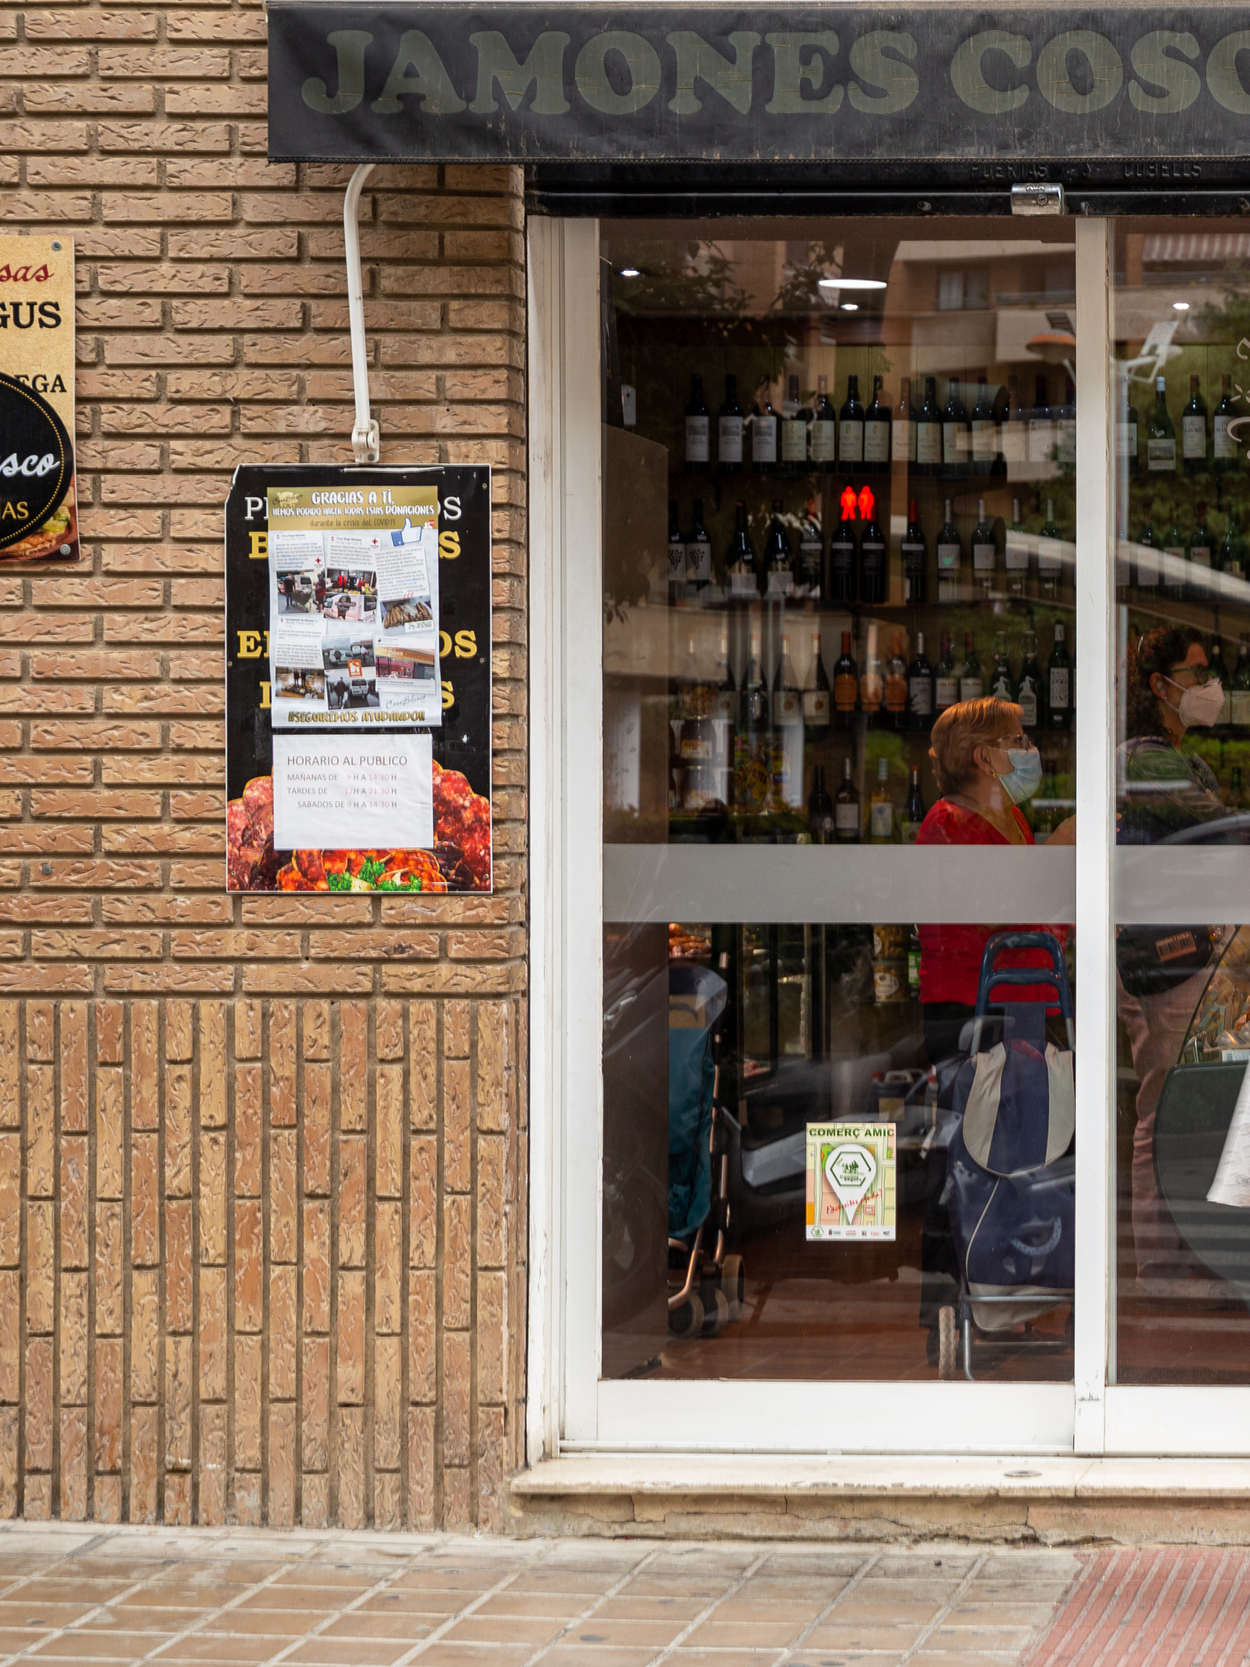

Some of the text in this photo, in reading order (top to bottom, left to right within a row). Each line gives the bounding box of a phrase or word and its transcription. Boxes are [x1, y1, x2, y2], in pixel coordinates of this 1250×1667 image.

[301, 28, 919, 117] JAMONES
[311, 491, 364, 505] GRACIAS
[368, 491, 379, 504] A
[272, 508, 295, 516] HEMOS
[296, 508, 322, 516] PODIDO
[323, 508, 342, 516] HACER
[366, 507, 384, 515] ESTAS
[385, 505, 435, 515] DONACIONES
[309, 519, 334, 527] durante
[287, 755, 408, 766] HORARIO AL PUBLICO
[287, 772, 327, 781] MAÑANAS
[287, 787, 316, 795] TARDES
[318, 787, 328, 795] DE
[361, 787, 367, 795] A
[369, 787, 390, 795] 21.30
[391, 787, 397, 795] H
[809, 1128, 894, 1138] COMERÇ AMIC
